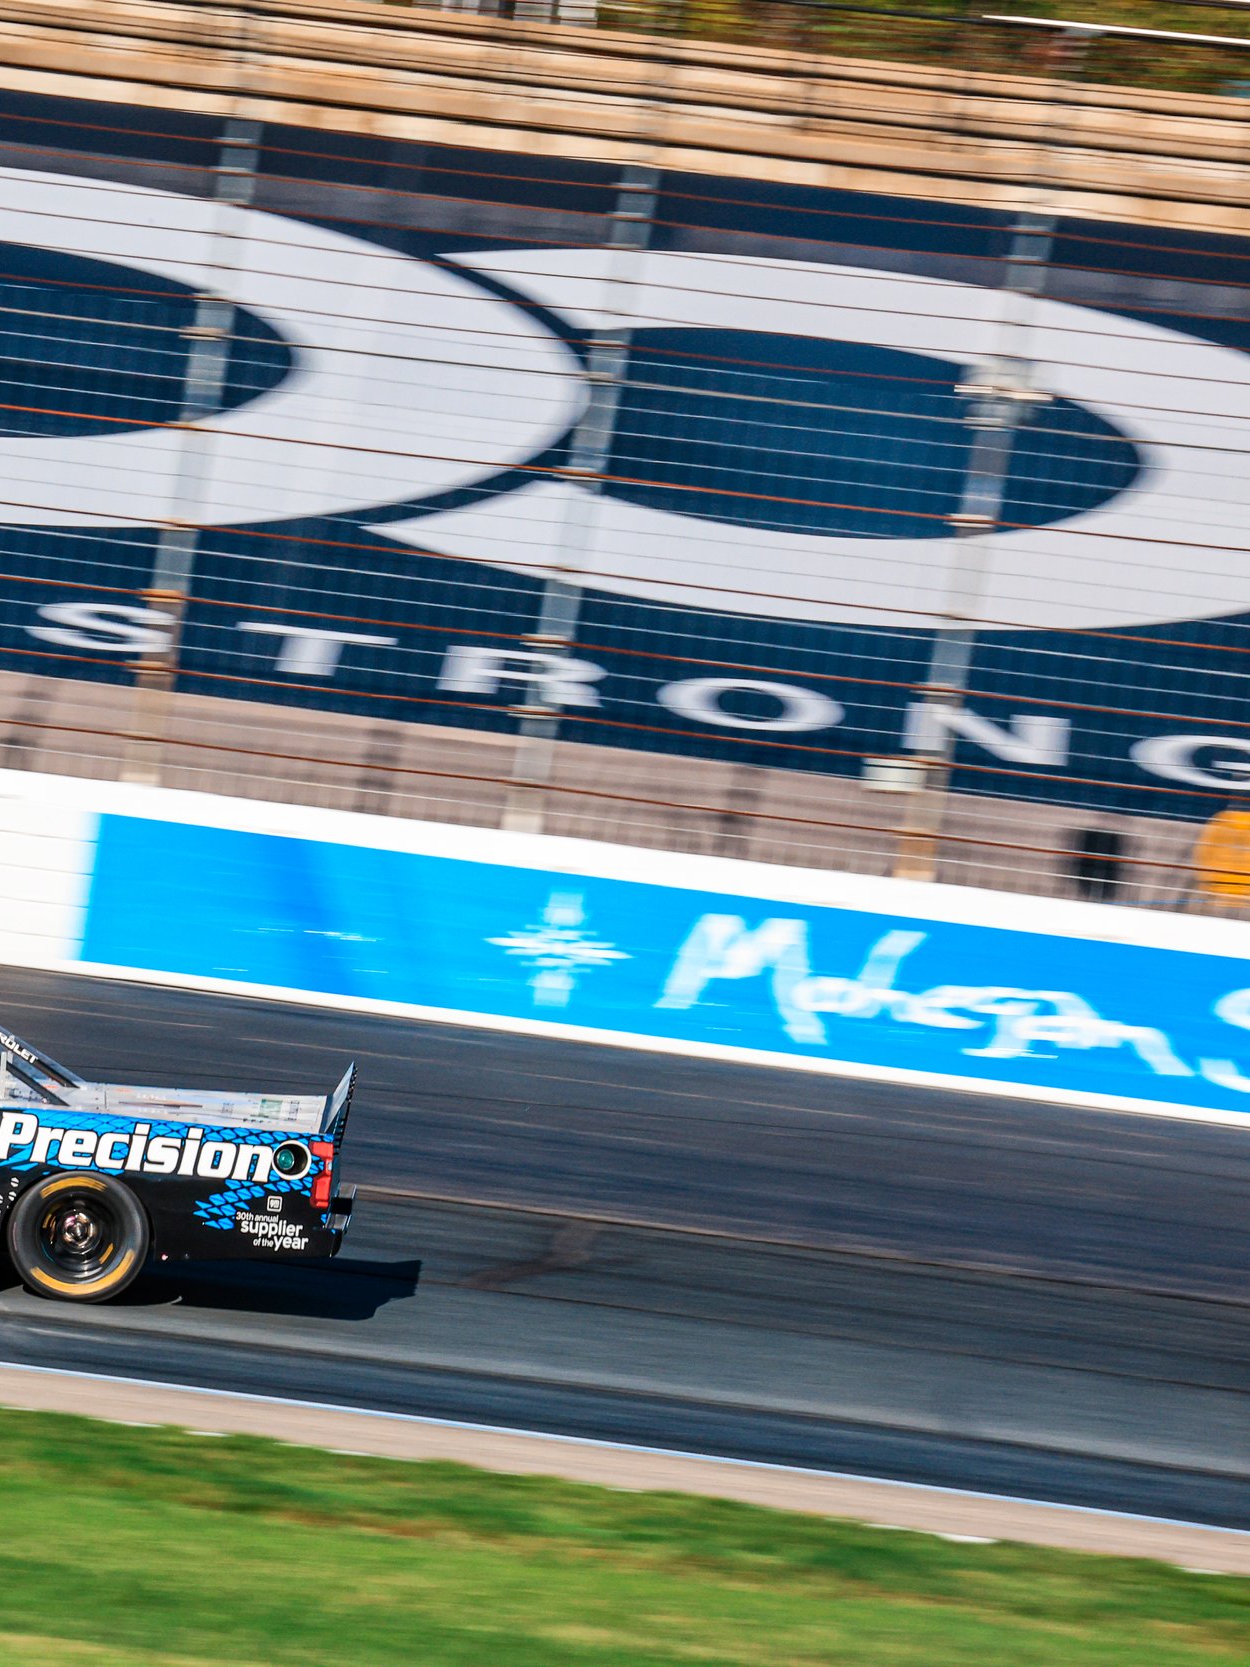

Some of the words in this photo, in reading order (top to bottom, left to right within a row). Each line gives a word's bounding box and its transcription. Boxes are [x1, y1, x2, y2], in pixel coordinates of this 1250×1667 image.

[24, 602, 1250, 791] STRONG
[236, 1211, 254, 1221] 30th
[254, 1214, 279, 1223] annual
[240, 1219, 304, 1238] supplier
[253, 1237, 261, 1246] of
[261, 1238, 274, 1247] the
[273, 1235, 309, 1251] year
